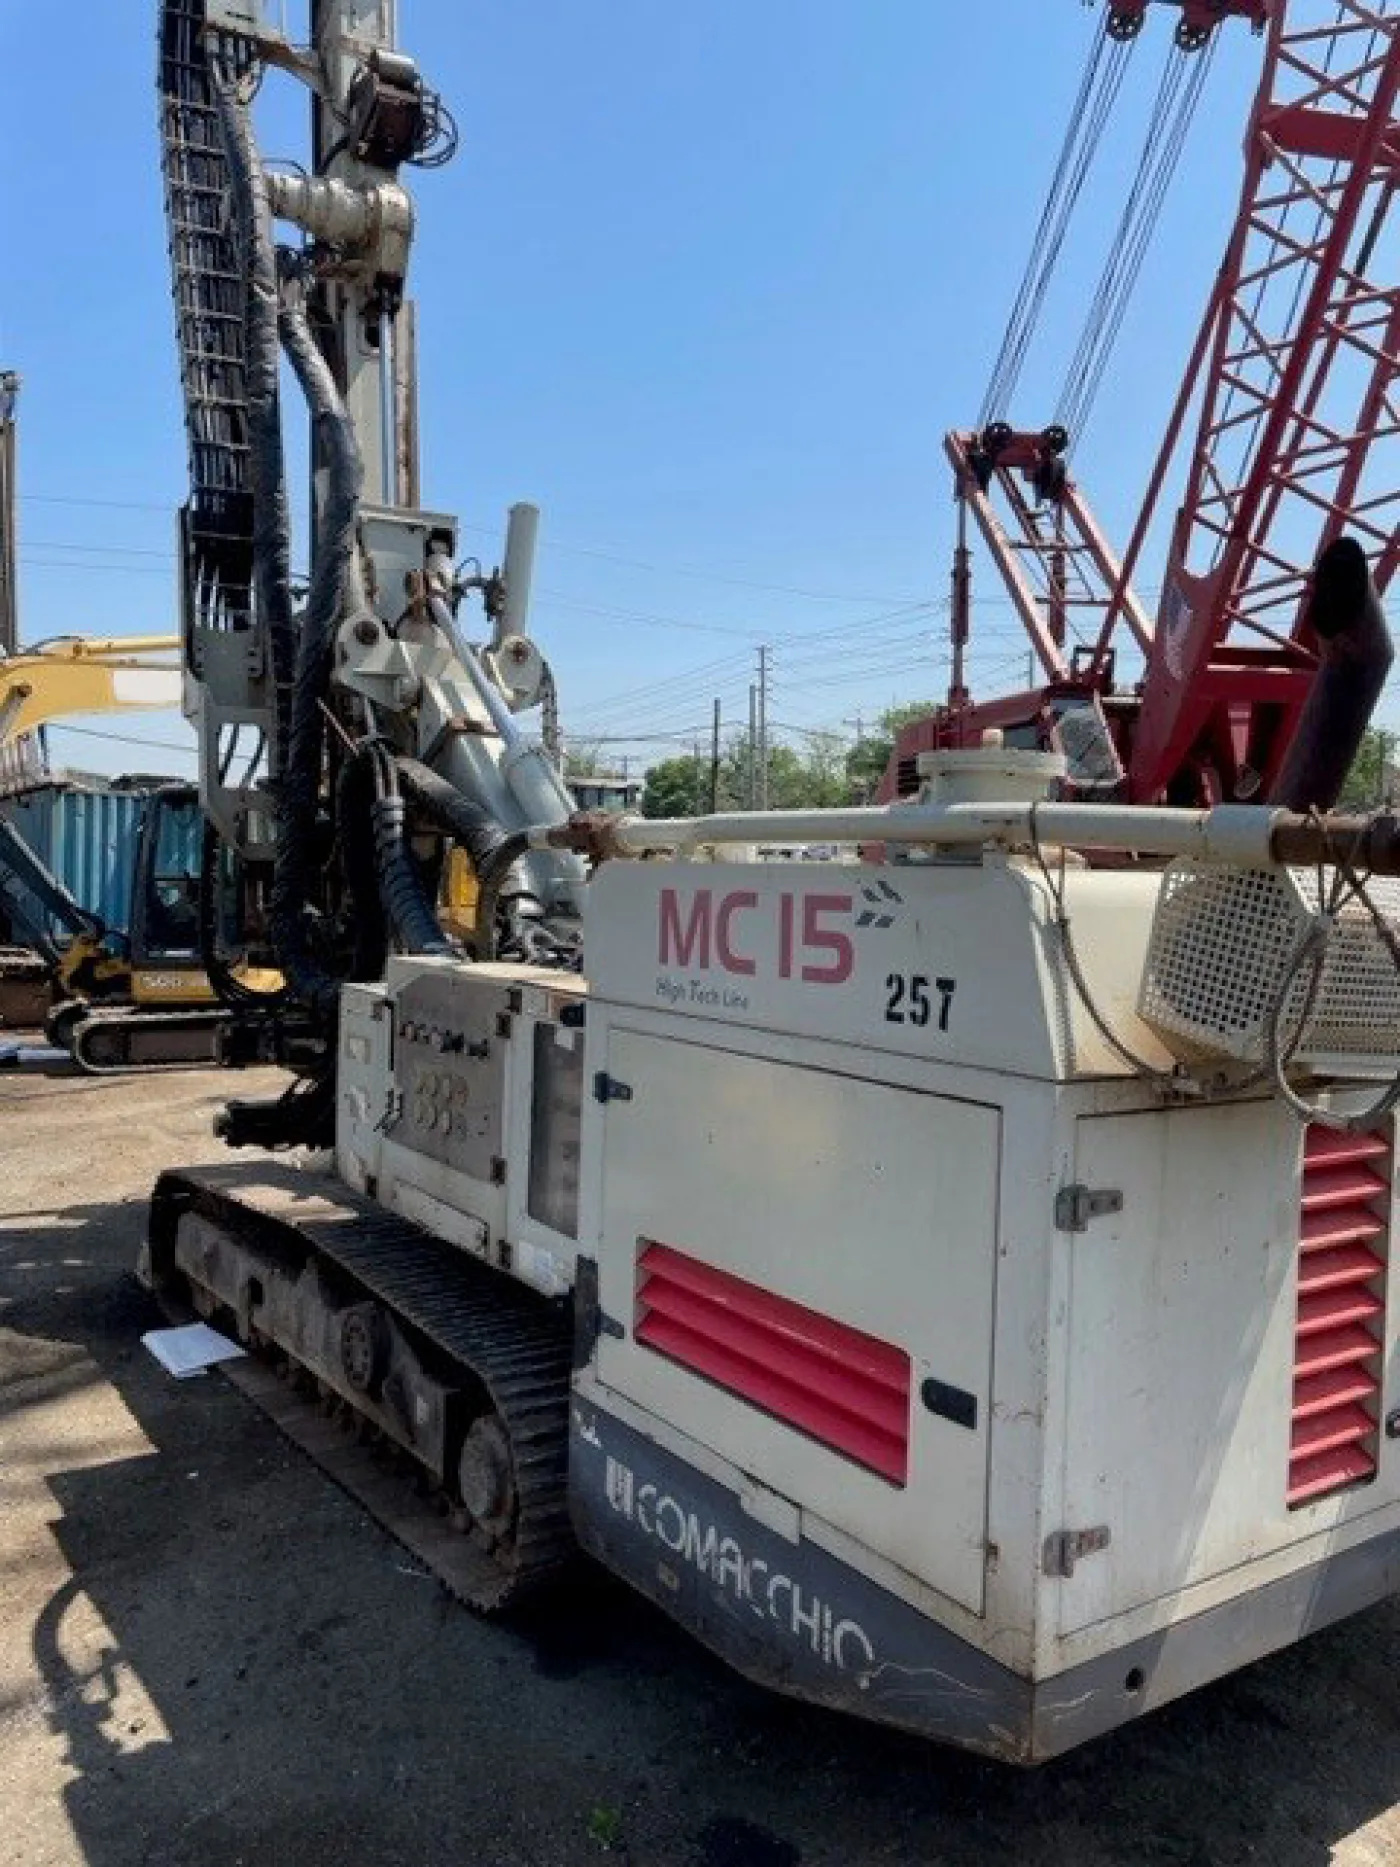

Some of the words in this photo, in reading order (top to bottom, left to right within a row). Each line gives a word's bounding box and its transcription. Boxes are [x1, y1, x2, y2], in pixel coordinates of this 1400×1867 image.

[659, 888, 758, 976] MC
[778, 893, 854, 984] 15
[690, 979, 720, 1005] Tech
